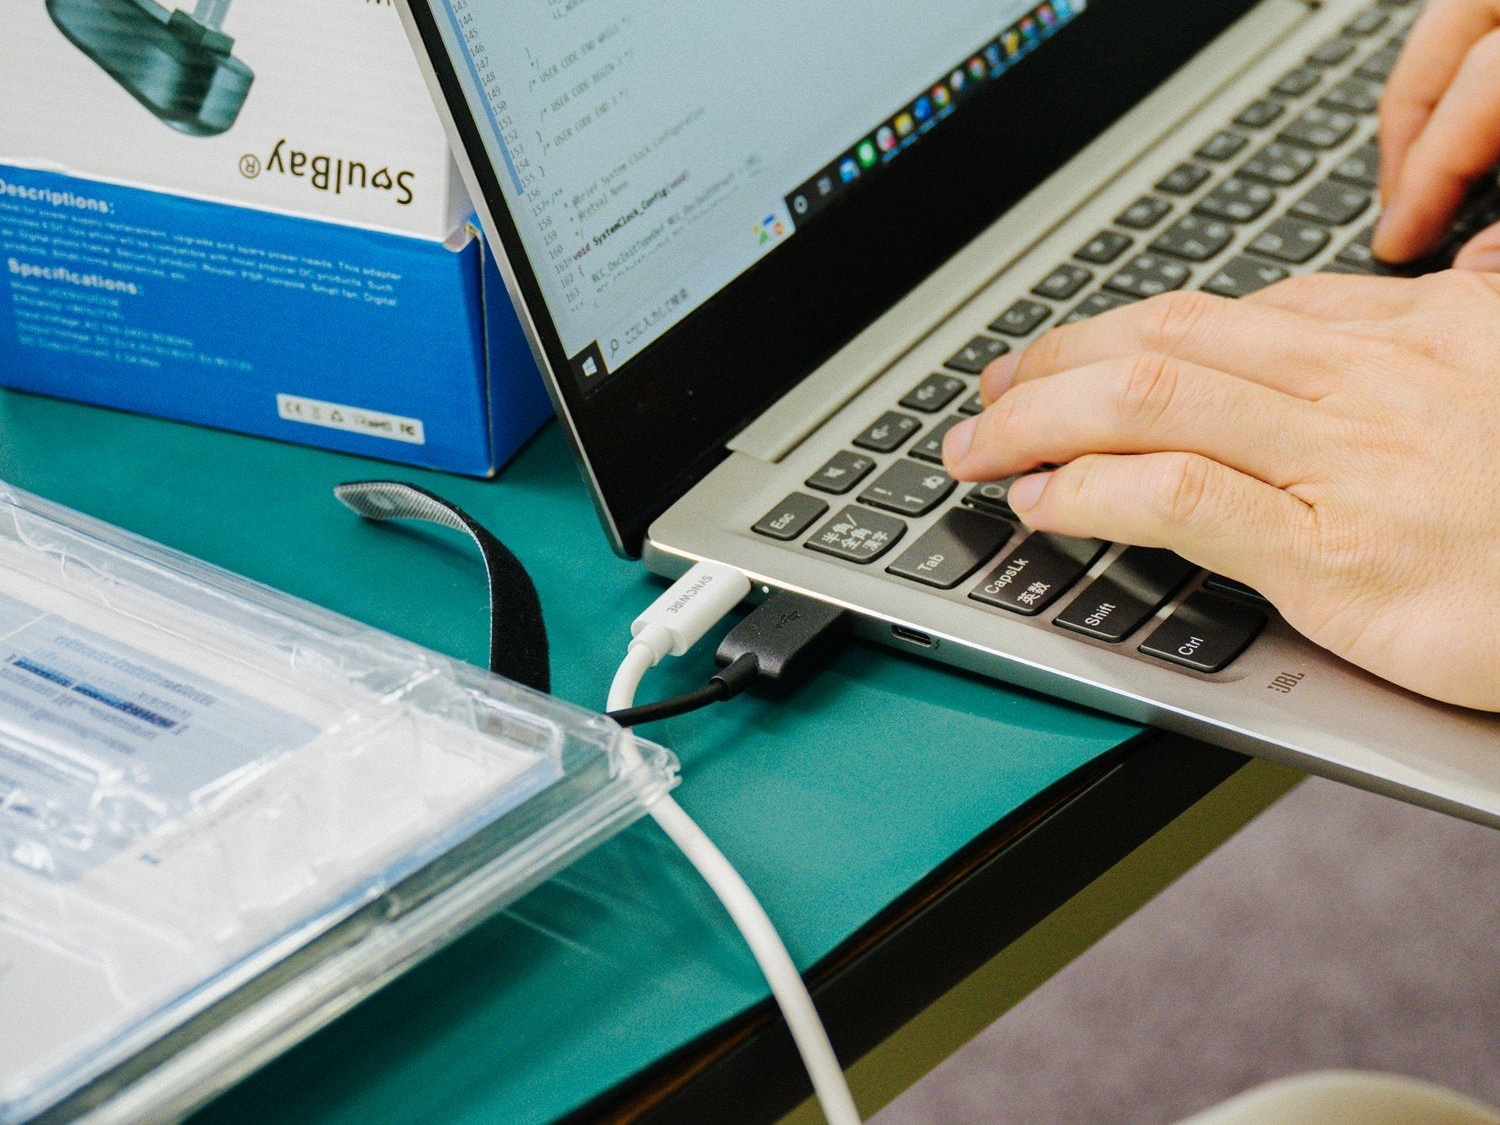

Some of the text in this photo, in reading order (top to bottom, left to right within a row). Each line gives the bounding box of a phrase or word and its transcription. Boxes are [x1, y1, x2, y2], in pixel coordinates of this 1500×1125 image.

[458, 12, 474, 30] 144
[463, 26, 480, 44] 145
[469, 41, 485, 59] 146
[475, 55, 491, 73] 147
[480, 70, 497, 88] 148
[486, 84, 502, 102] 149
[492, 99, 508, 117] 150
[497, 113, 513, 131] 151
[503, 128, 519, 146] 152
[509, 142, 525, 160] 153
[514, 157, 530, 175] 154
[520, 171, 536, 189] 155
[525, 185, 541, 203] 156
[531, 199, 547, 218] 157
[537, 214, 552, 232] 158
[542, 228, 558, 246] 159
[548, 242, 563, 260] 160
[553, 256, 569, 274] 161
[559, 270, 574, 289] 162
[564, 285, 580, 303] 163
[903, 494, 925, 505] 1
[769, 512, 796, 530] Esc
[821, 513, 858, 544] 半角/
[841, 527, 873, 550] 全角
[862, 531, 889, 551] 漢字
[916, 553, 945, 572] Tab
[984, 556, 1030, 596] CapsLk
[1016, 581, 1052, 607] 英数
[1084, 601, 1116, 628] Shift
[1177, 635, 1204, 657] Ctrl
[1266, 671, 1306, 695] JBL
